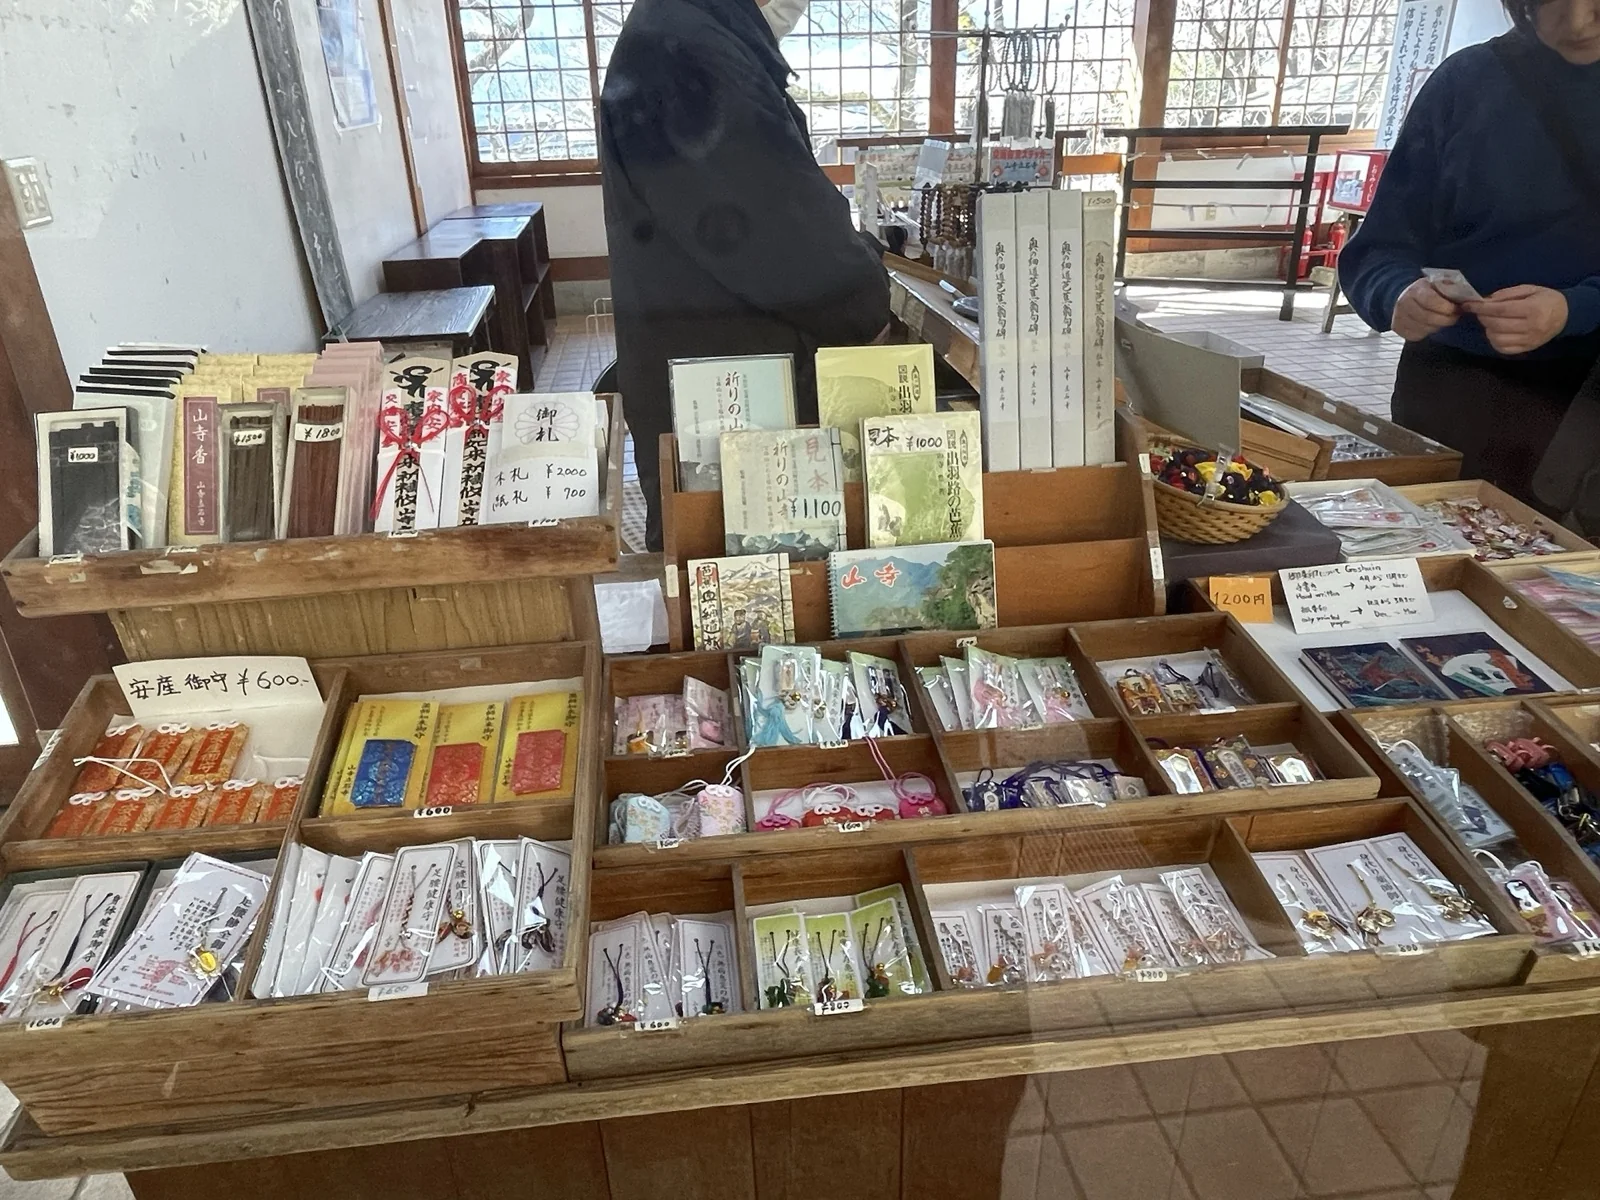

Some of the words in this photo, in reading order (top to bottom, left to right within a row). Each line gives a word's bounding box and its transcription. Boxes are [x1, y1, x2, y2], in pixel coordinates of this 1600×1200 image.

[192, 408, 208, 465] 山寺香
[536, 407, 559, 442] 御札
[868, 427, 899, 447] 見本
[546, 464, 588, 479] ¥2000
[773, 440, 789, 520] 祈りの山寺
[806, 437, 829, 493] 見本
[841, 562, 902, 589] 山寺
[1213, 591, 1265, 607] 1200円
